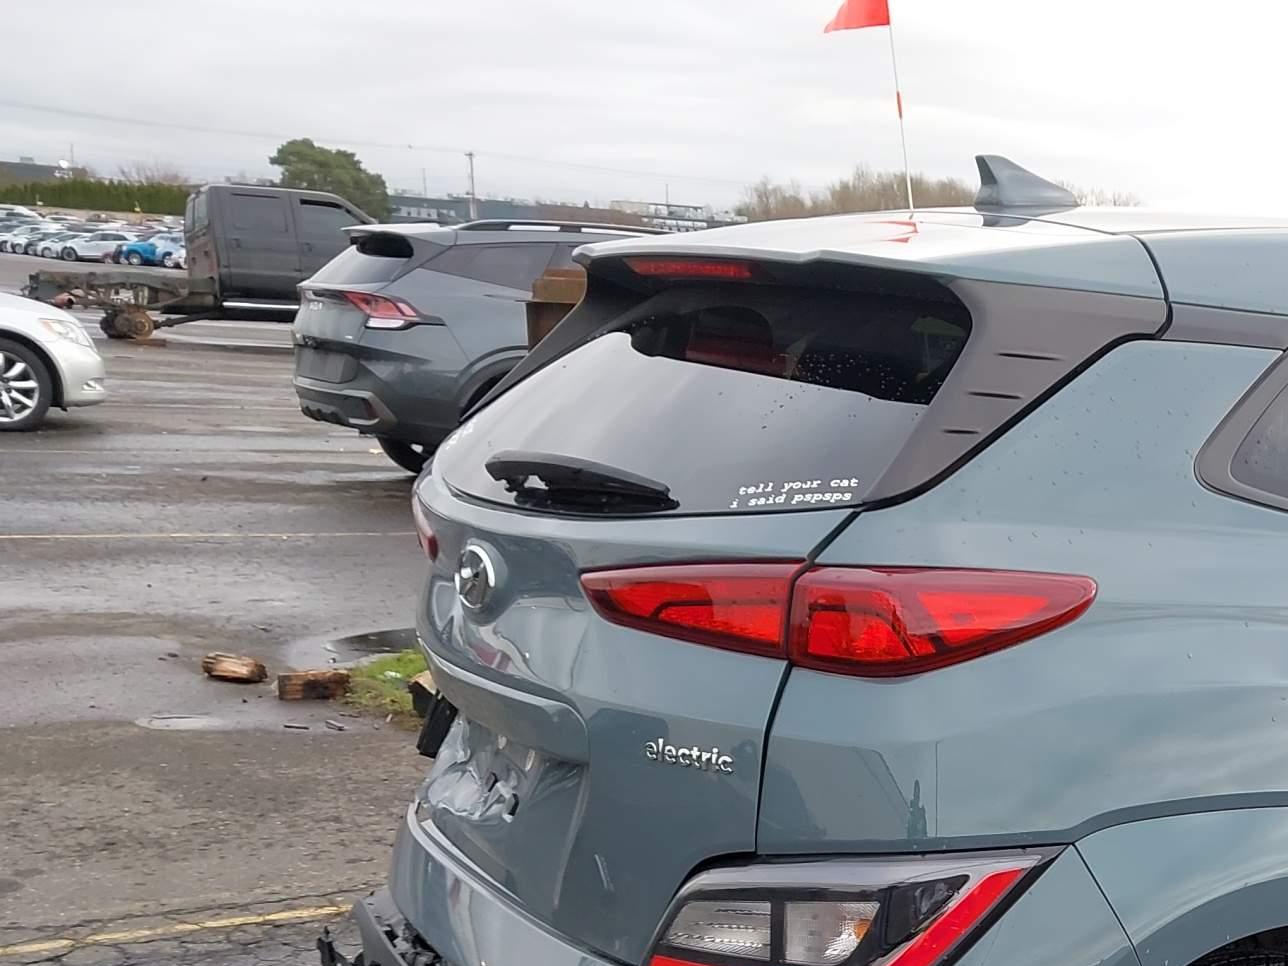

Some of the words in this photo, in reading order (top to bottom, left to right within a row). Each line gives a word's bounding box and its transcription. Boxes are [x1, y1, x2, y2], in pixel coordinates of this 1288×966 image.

[739, 482, 774, 495] tell
[781, 479, 821, 492] your
[830, 477, 859, 487] cat
[729, 498, 739, 508] i
[748, 493, 786, 506] said
[791, 492, 852, 504] pspsps
[645, 737, 733, 772] electric
